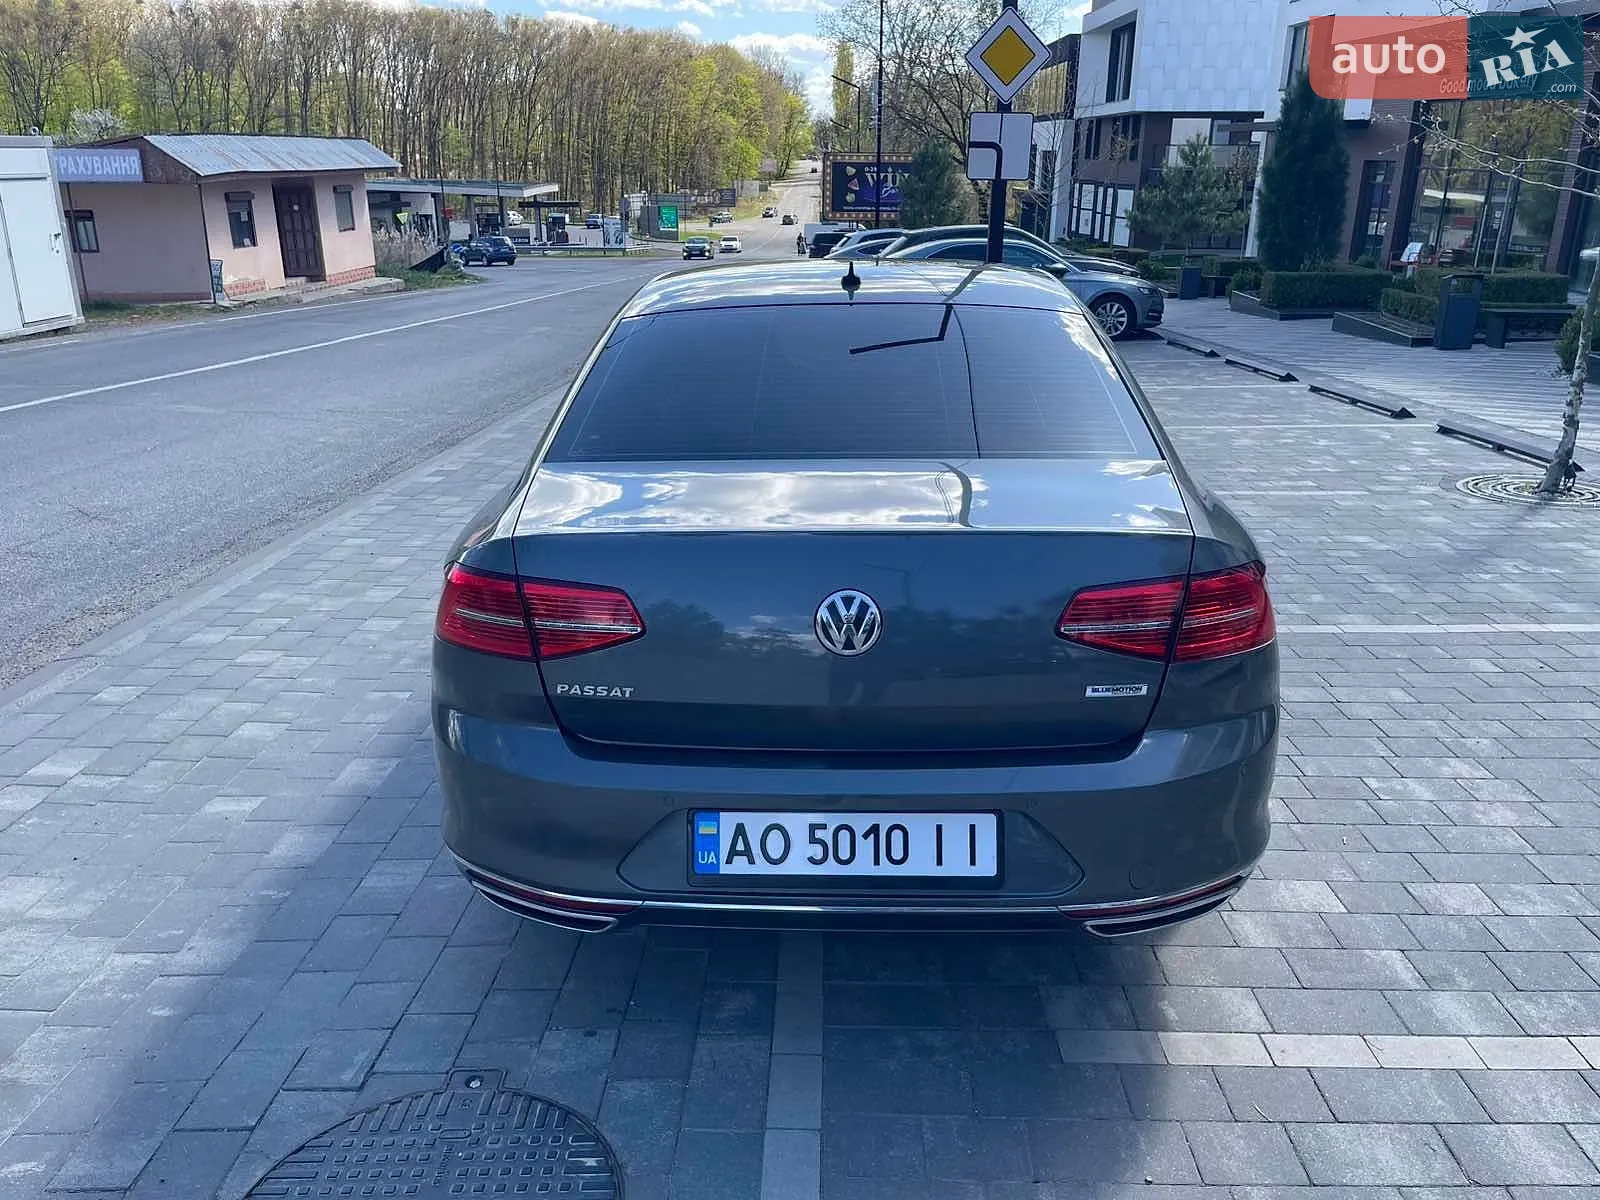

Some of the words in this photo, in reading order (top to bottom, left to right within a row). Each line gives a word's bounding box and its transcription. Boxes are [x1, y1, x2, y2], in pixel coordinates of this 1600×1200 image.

[1439, 78, 1466, 94] Good
[556, 683, 634, 698] PASSAT
[1091, 686, 1143, 694] BLUEMOTION
[725, 823, 791, 865] AO
[807, 823, 909, 866] 5010
[698, 851, 717, 864] UA
